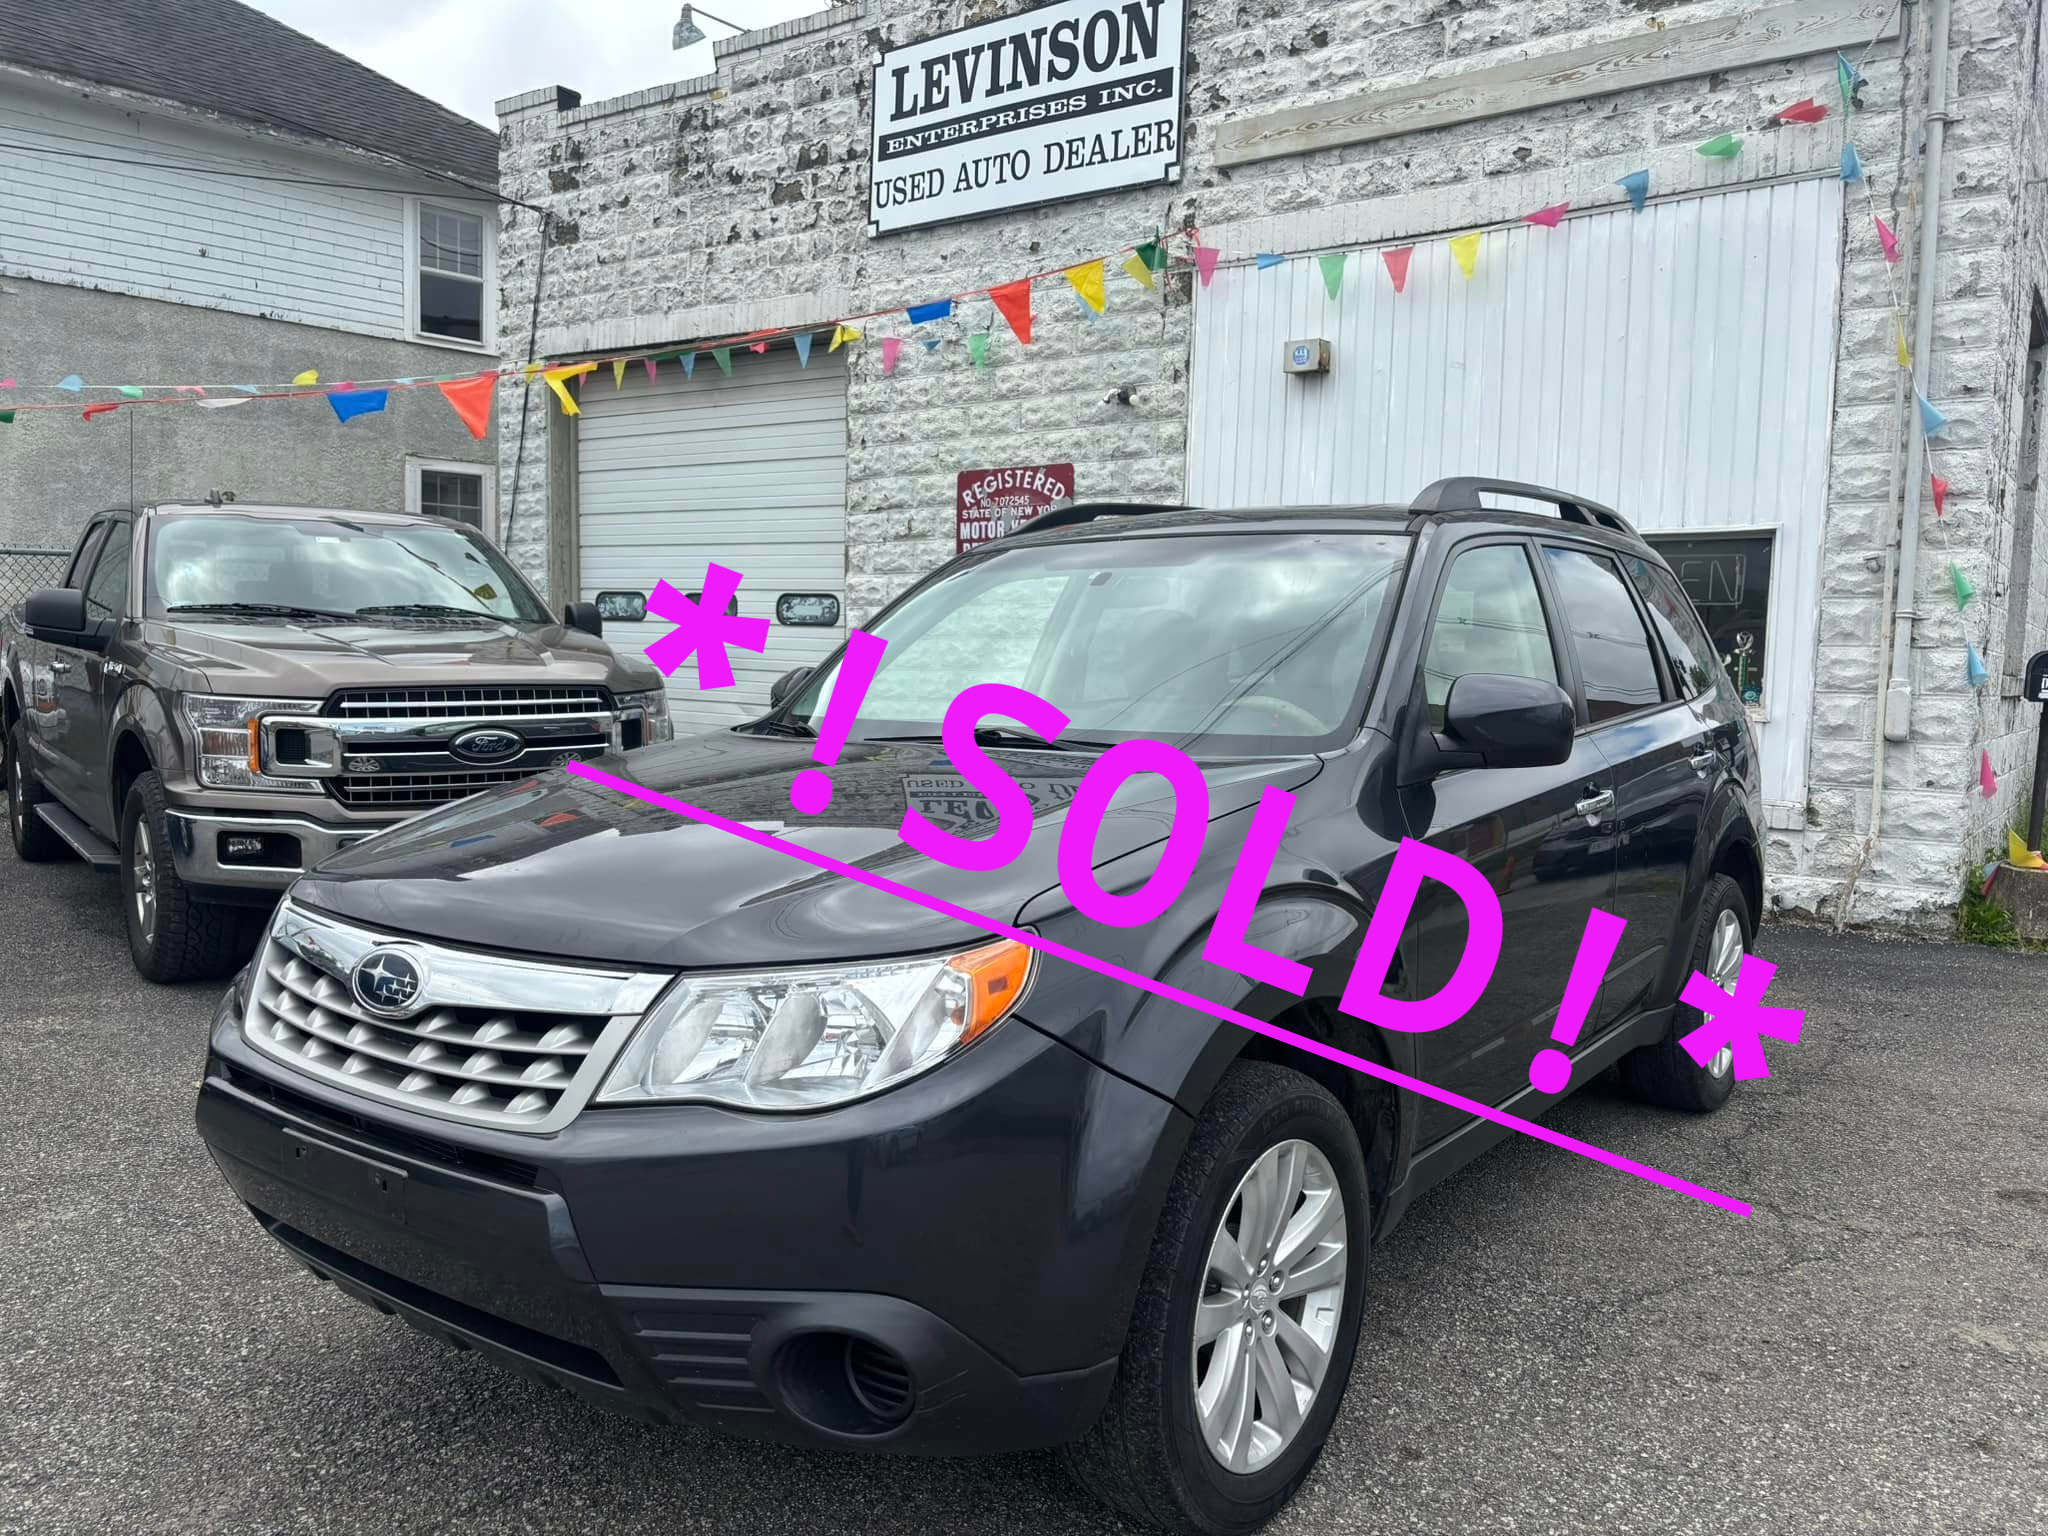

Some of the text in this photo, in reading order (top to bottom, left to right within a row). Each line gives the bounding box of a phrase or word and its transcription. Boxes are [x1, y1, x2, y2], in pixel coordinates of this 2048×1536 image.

[890, 0, 1164, 122] LEVINSON
[886, 79, 1163, 154] ENTERPRISES INC.
[874, 119, 1176, 209] USED AUTO DEALER
[962, 470, 1065, 507] REGISTERED
[960, 521, 1004, 540] MOTOR
[962, 508, 990, 519] STATE
[994, 507, 1007, 517] OF
[1011, 505, 1032, 516] NEW
[471, 736, 507, 752] Ford
